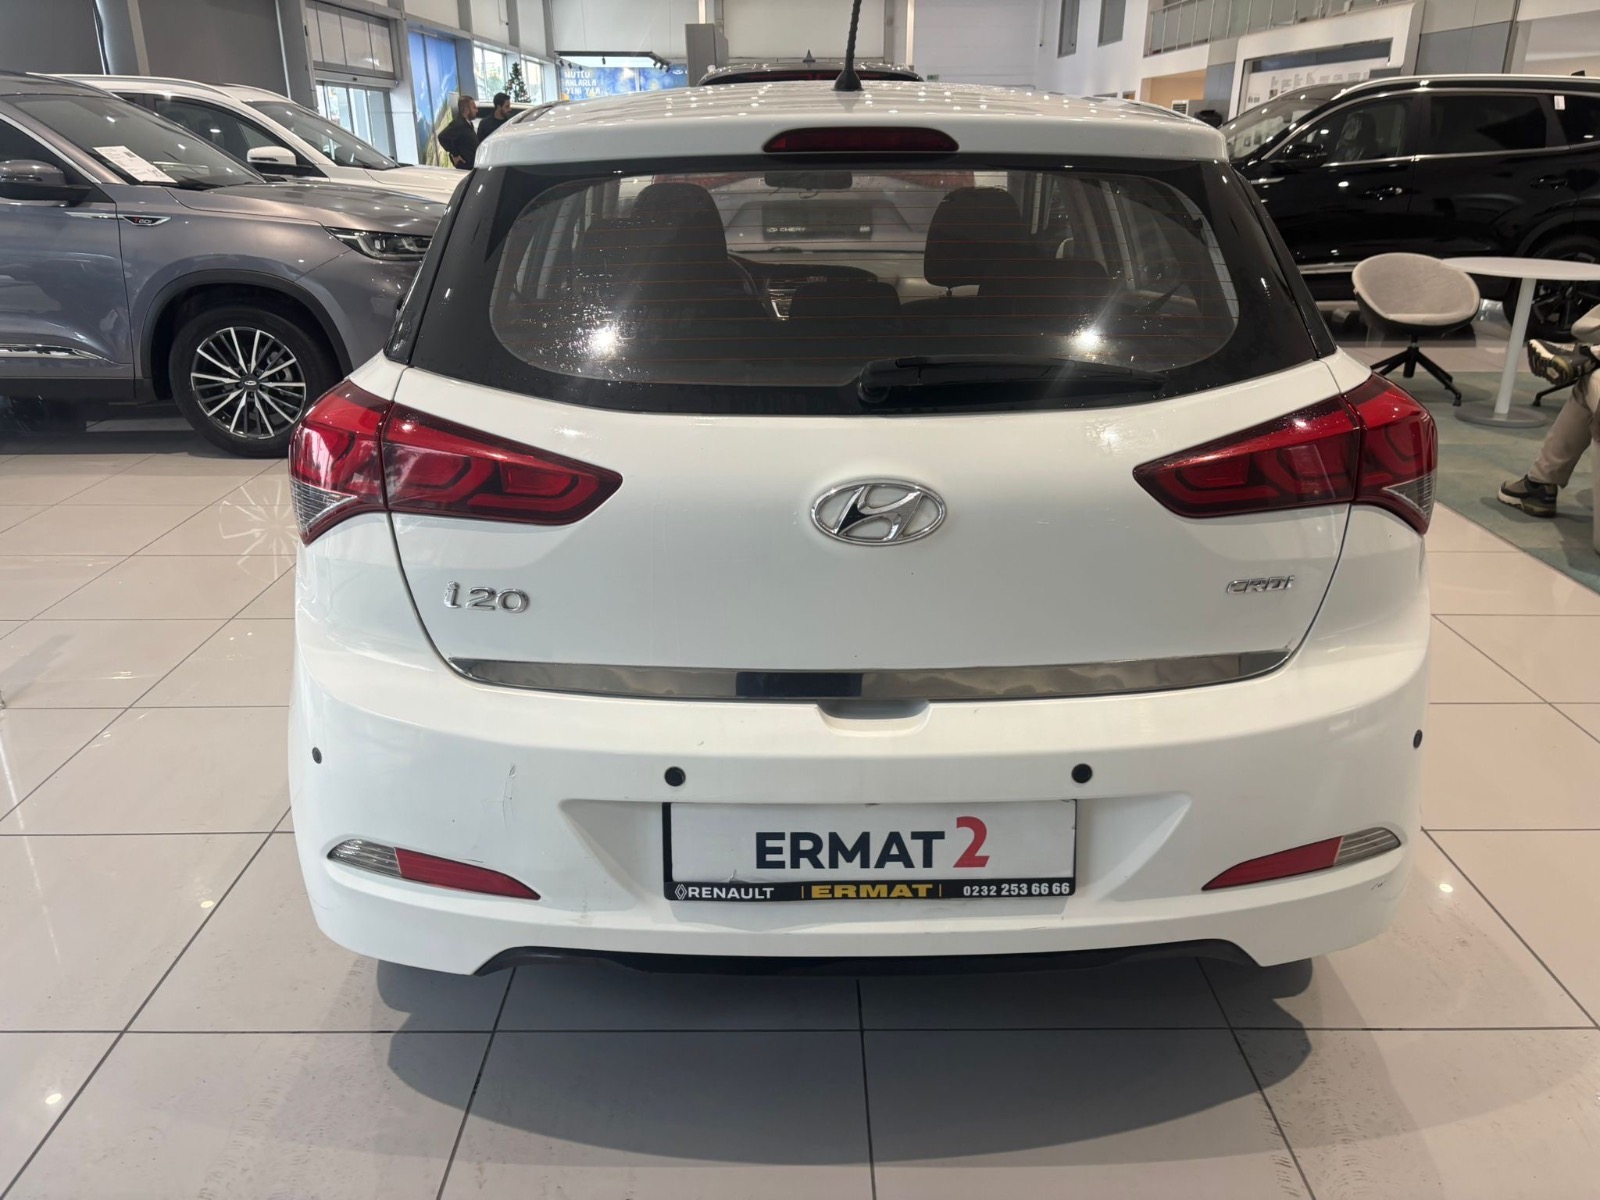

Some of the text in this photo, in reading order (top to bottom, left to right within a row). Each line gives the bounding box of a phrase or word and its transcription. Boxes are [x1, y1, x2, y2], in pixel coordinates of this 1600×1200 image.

[756, 816, 990, 869] ERMAT 2
[688, 882, 1070, 899] RENAULT ERMAT 0232 253 66 66
